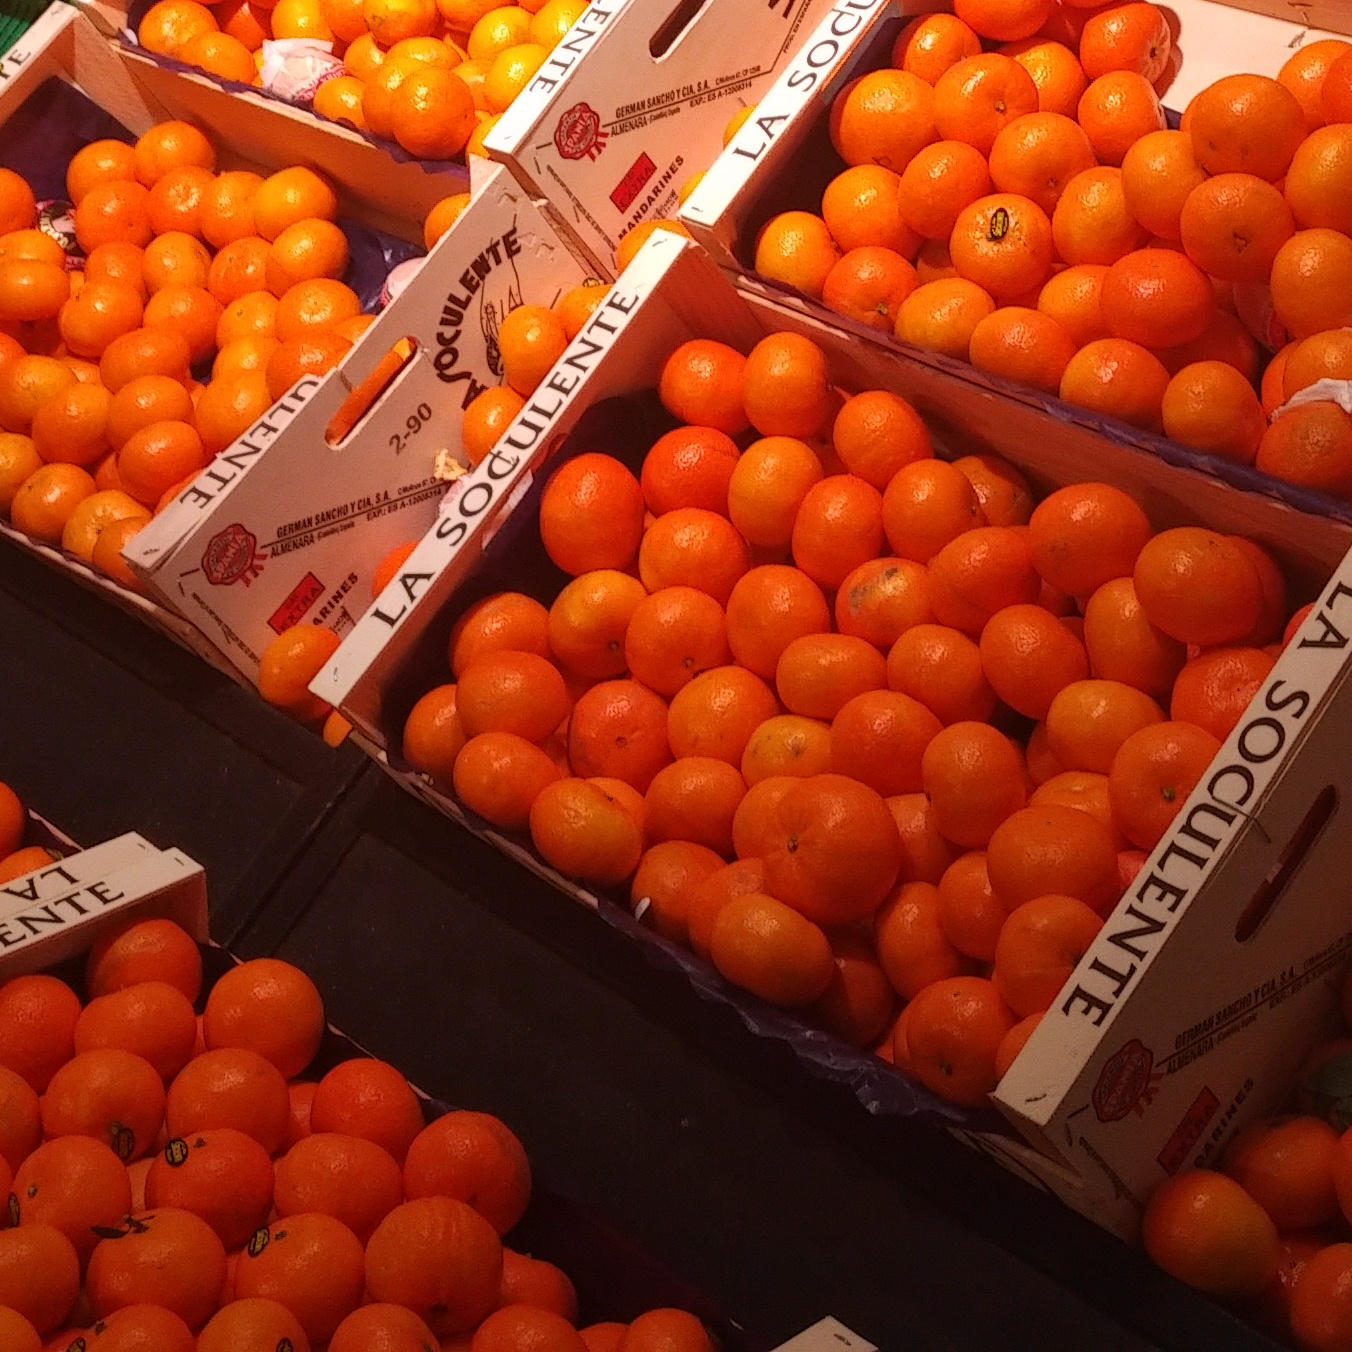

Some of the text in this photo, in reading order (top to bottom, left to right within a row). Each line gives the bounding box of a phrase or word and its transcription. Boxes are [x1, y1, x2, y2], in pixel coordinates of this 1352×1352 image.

[615, 102, 646, 119] GERMAN
[647, 95, 675, 109] SANCHO
[697, 80, 710, 93] S.A.
[611, 118, 648, 137] ALMENARA
[732, 112, 791, 161] LA
[618, 155, 684, 240] MANDARINES
[432, 215, 522, 384] SOCULENTE
[387, 402, 434, 456] 2-90
[371, 289, 641, 628] LA SOCULENTE
[276, 519, 313, 538] GERMAN
[314, 506, 349, 526] SANCHO
[357, 497, 374, 510] CIA,
[375, 490, 392, 504] S.A.
[270, 536, 315, 559] ALMENARA
[1062, 679, 1311, 1027] SOCULENTE
[1, 865, 86, 902] LA
[1175, 1021, 1214, 1050] GERMAN
[1214, 993, 1252, 1026] SANCHO
[1166, 1037, 1215, 1075] ALMENARA
